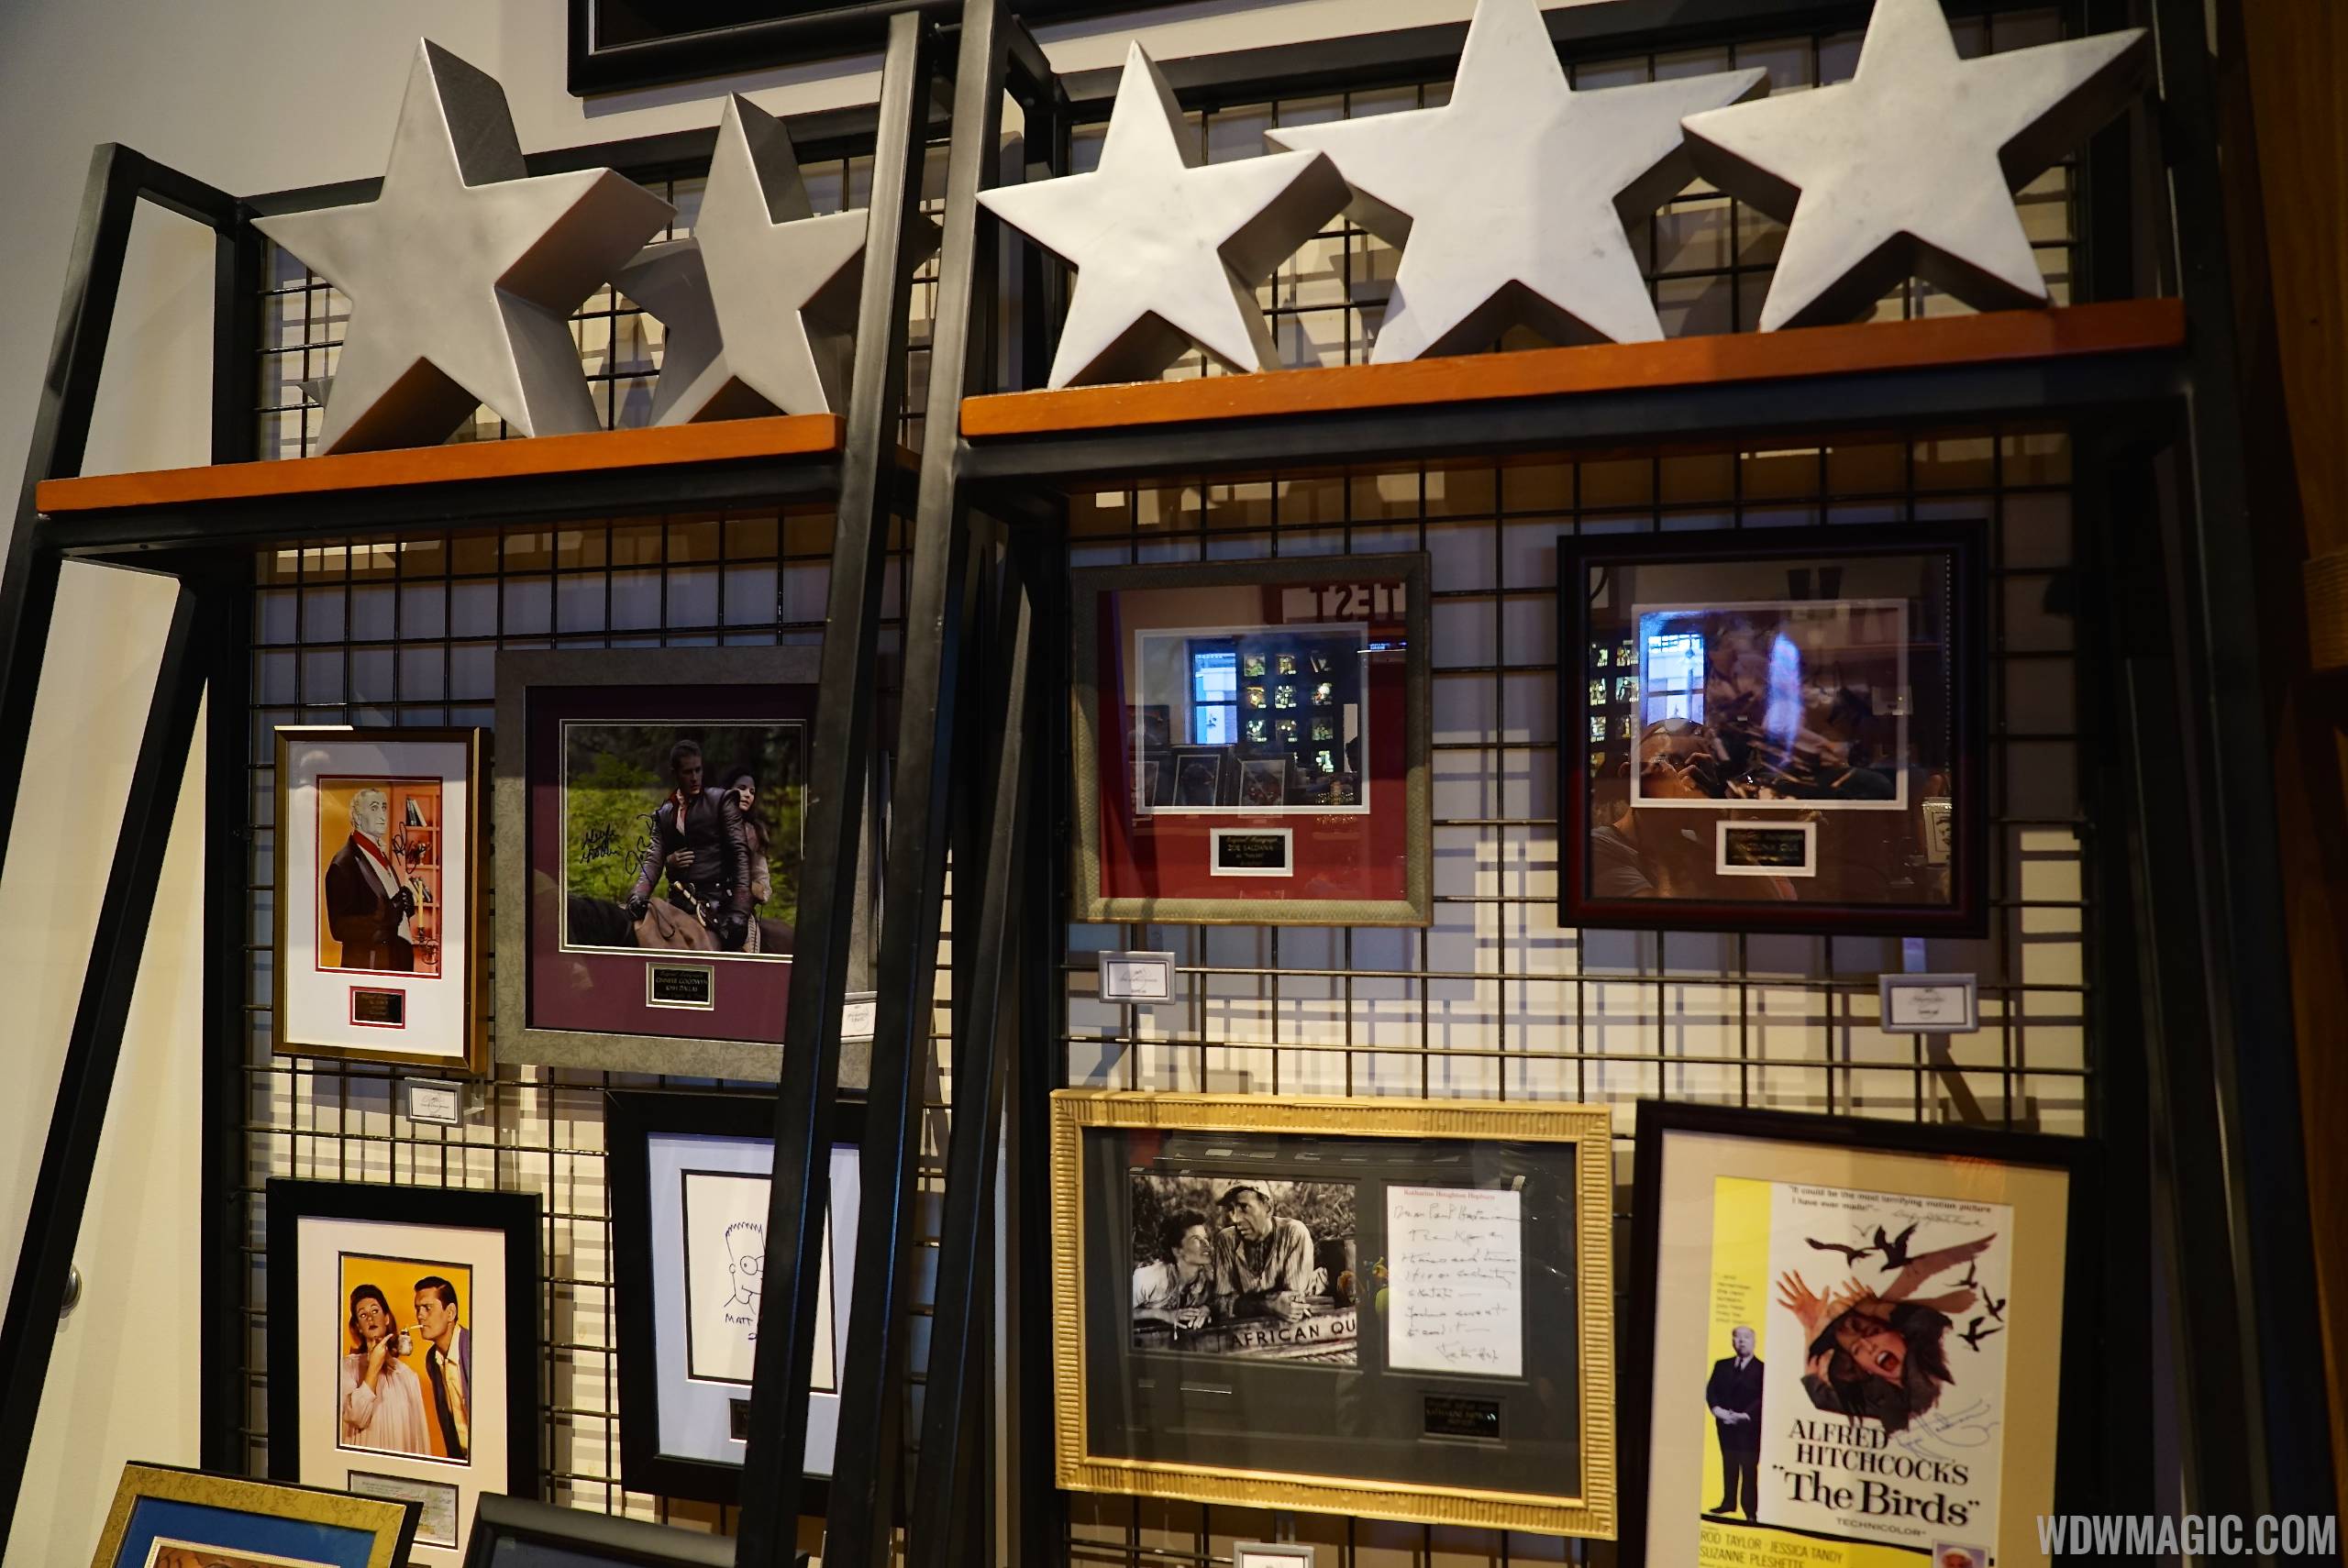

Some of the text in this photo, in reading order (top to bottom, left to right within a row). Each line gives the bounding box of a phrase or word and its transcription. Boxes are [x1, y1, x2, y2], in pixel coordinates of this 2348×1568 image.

[725, 1313, 753, 1326] MATT
[1233, 1323, 1320, 1348] AFRICAN
[1789, 1419, 1888, 1450] ALFRED
[1796, 1443, 1969, 1486] HITCHCOCK'S
[1700, 1530, 1844, 1564] ROD TAYLOR JESSICA TANDY
[1700, 1546, 1744, 1563] SUZANNE
